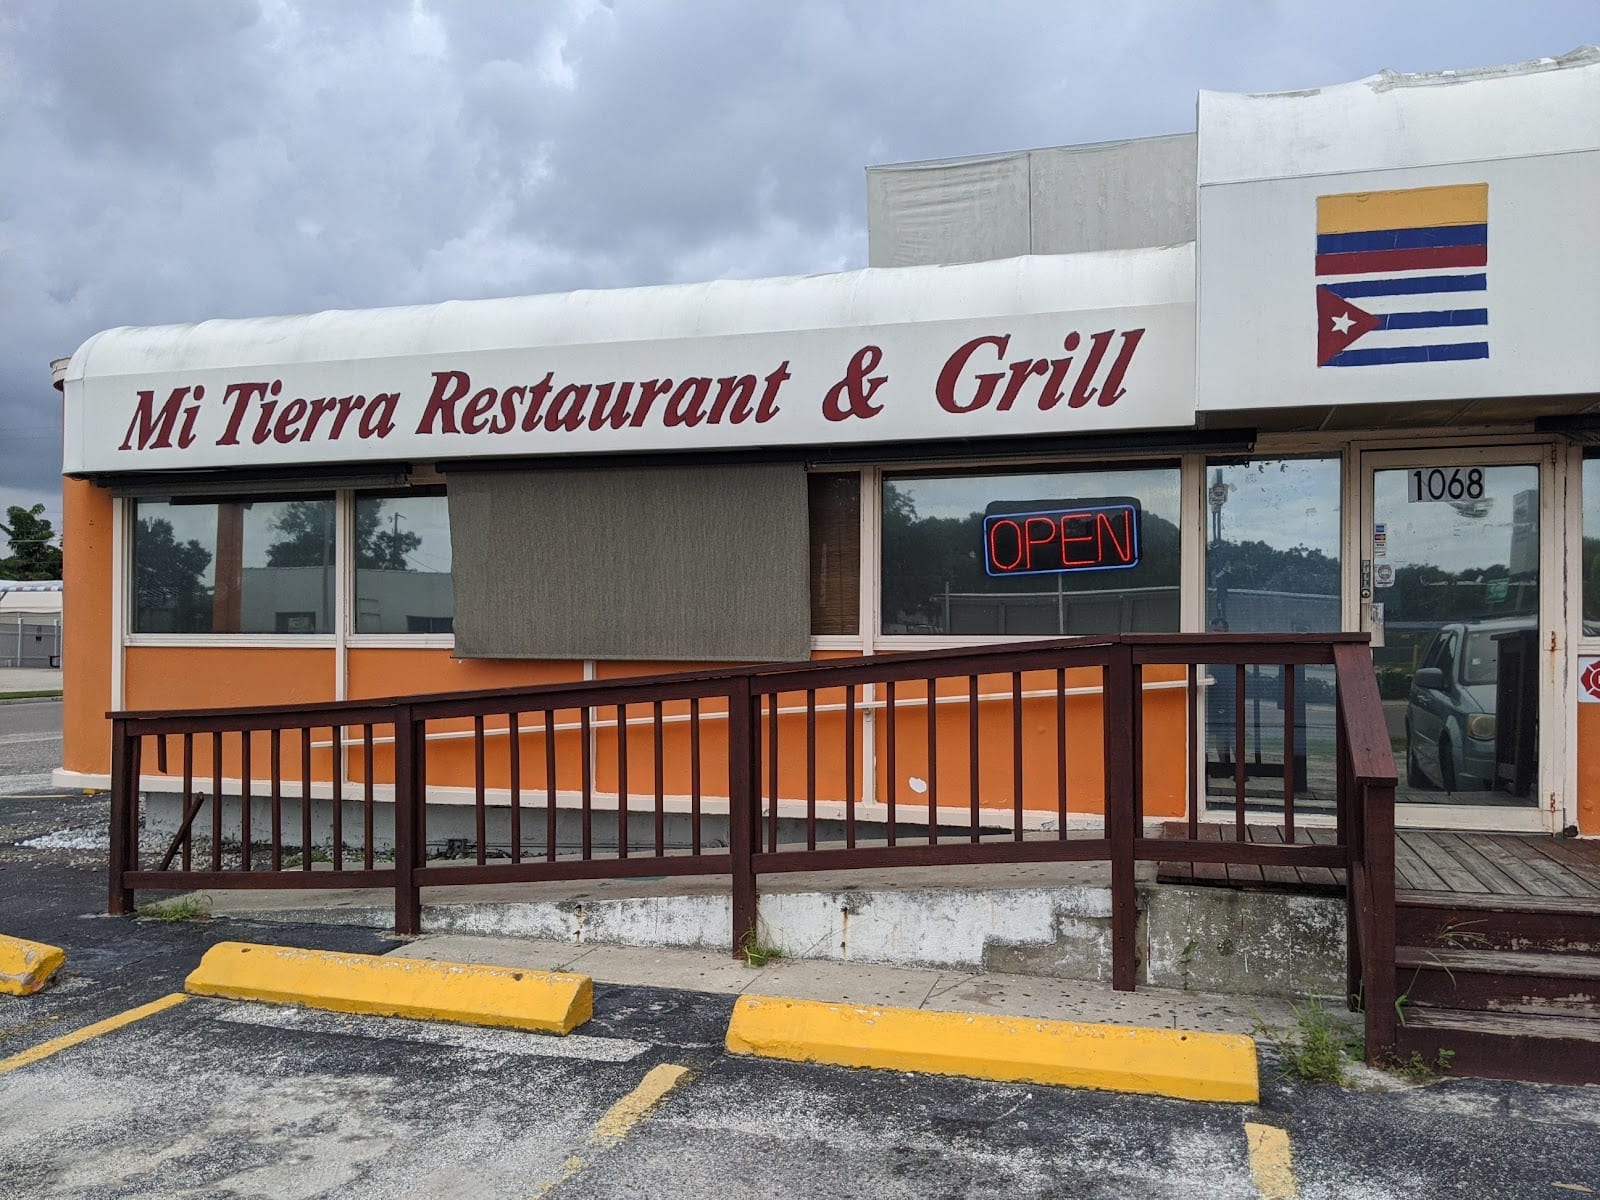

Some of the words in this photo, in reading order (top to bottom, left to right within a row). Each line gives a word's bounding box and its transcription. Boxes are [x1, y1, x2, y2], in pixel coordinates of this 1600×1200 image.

[118, 384, 205, 451] Mi
[215, 379, 401, 446] Tierra
[415, 360, 791, 435] Restaurant
[822, 345, 888, 422] &
[935, 328, 1146, 414] Grill
[1413, 468, 1484, 501] 1068
[990, 509, 1132, 570] OPEN
